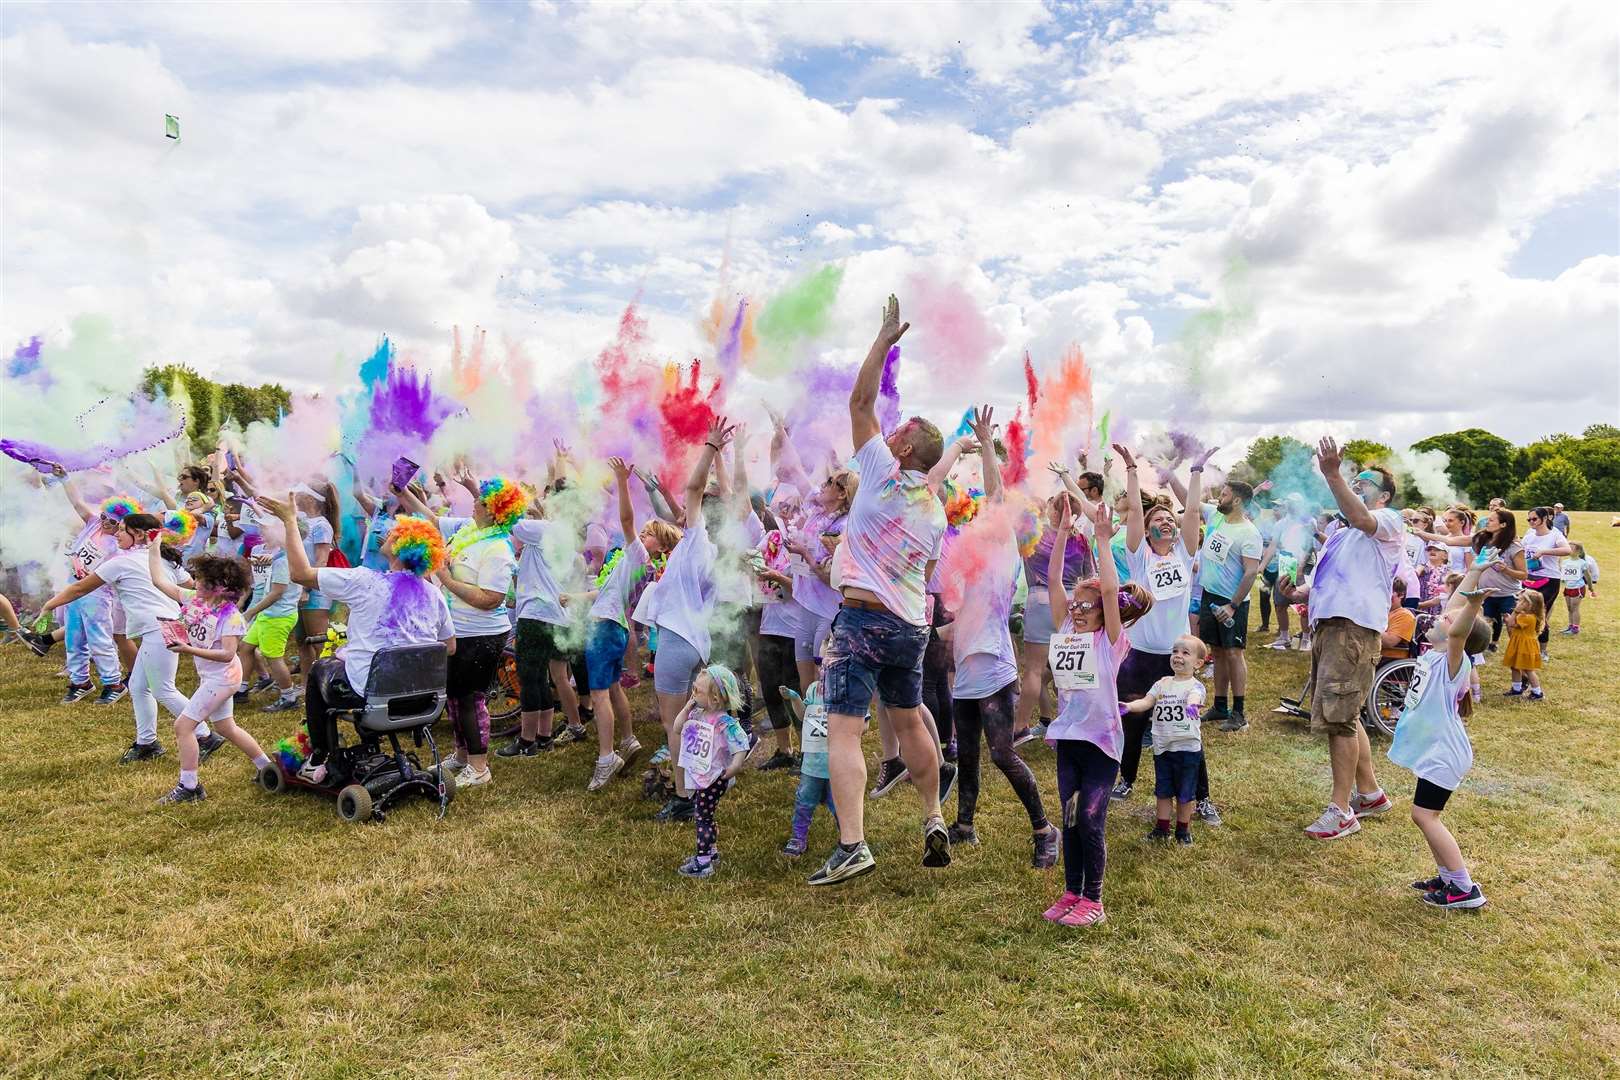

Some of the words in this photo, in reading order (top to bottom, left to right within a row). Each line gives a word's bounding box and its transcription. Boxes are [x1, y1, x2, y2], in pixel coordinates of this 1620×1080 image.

[1210, 540, 1222, 553] 58
[1155, 569, 1182, 588] 234
[1564, 568, 1577, 576] 290
[1055, 651, 1086, 671] 257
[1155, 705, 1185, 722] 233
[686, 735, 711, 758] 259
